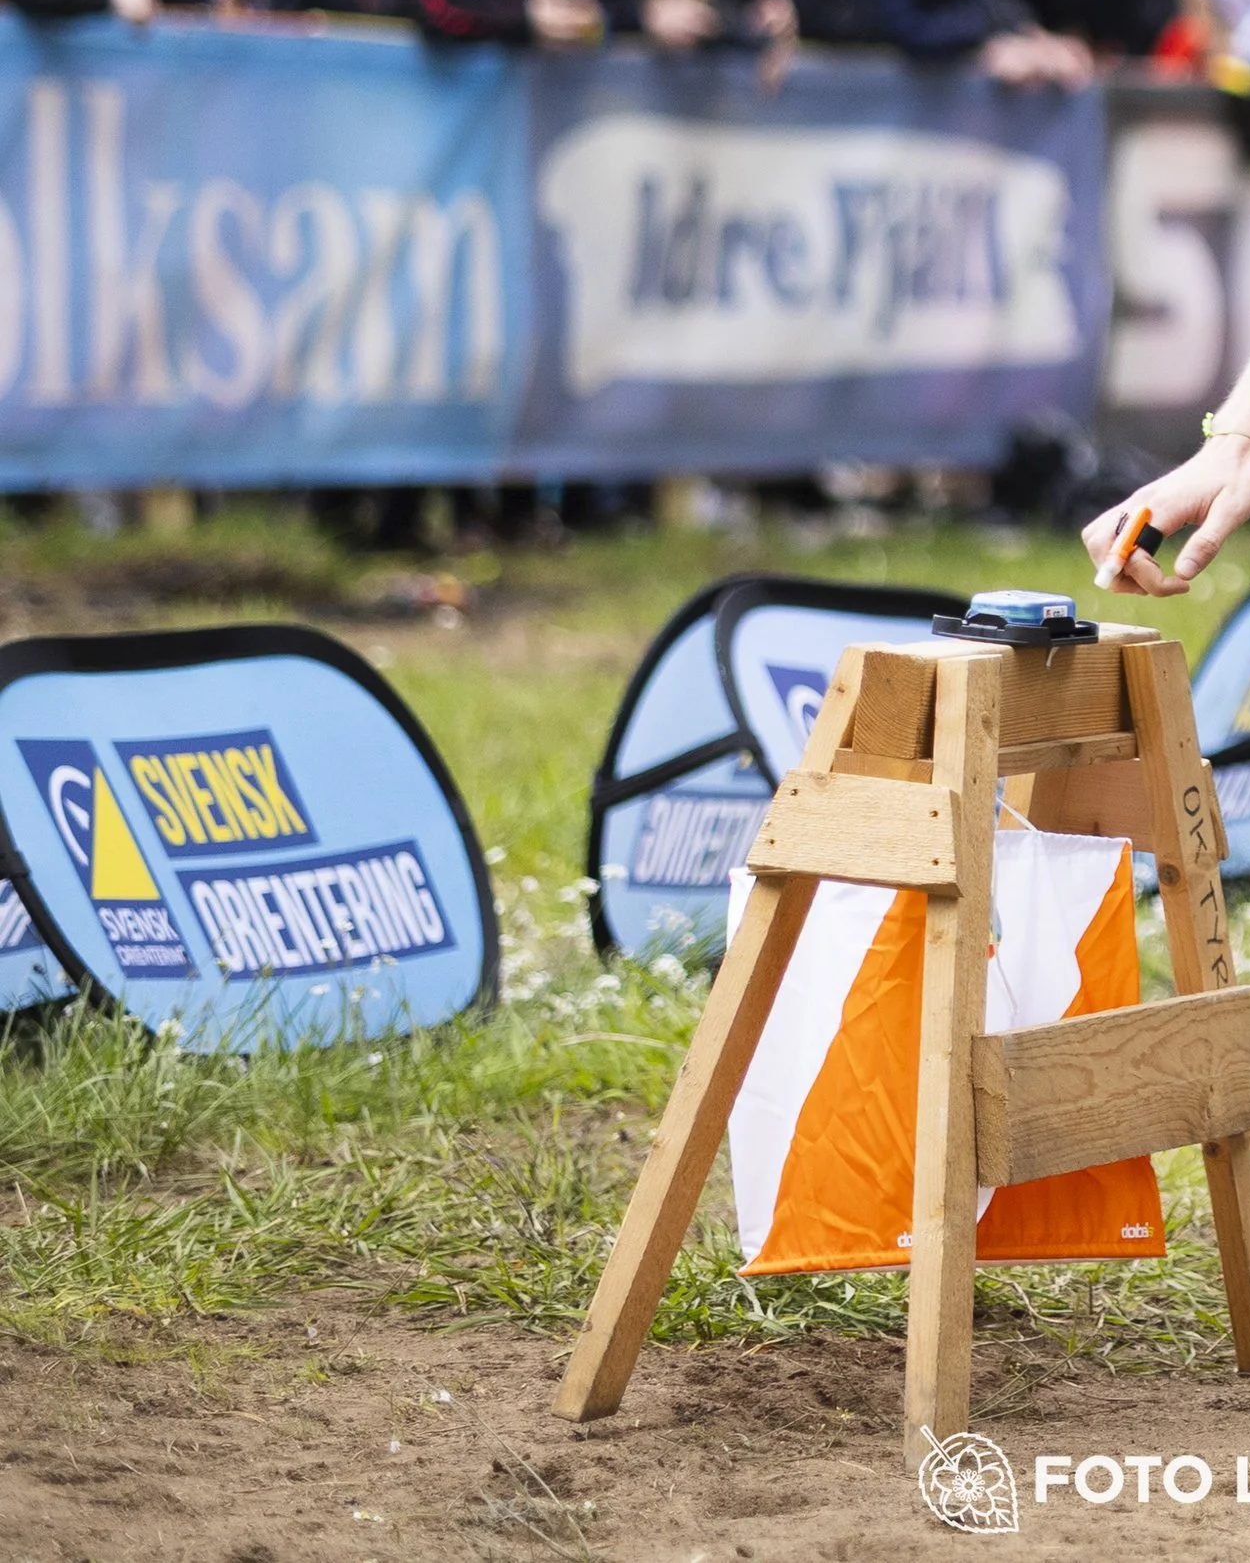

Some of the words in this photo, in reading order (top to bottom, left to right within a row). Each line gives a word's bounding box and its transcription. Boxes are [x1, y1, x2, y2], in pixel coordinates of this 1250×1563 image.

[0, 78, 506, 410] lksam
[130, 744, 308, 847] SVENSK
[98, 907, 180, 942] SVENSK
[190, 850, 446, 973] ORIENTERING
